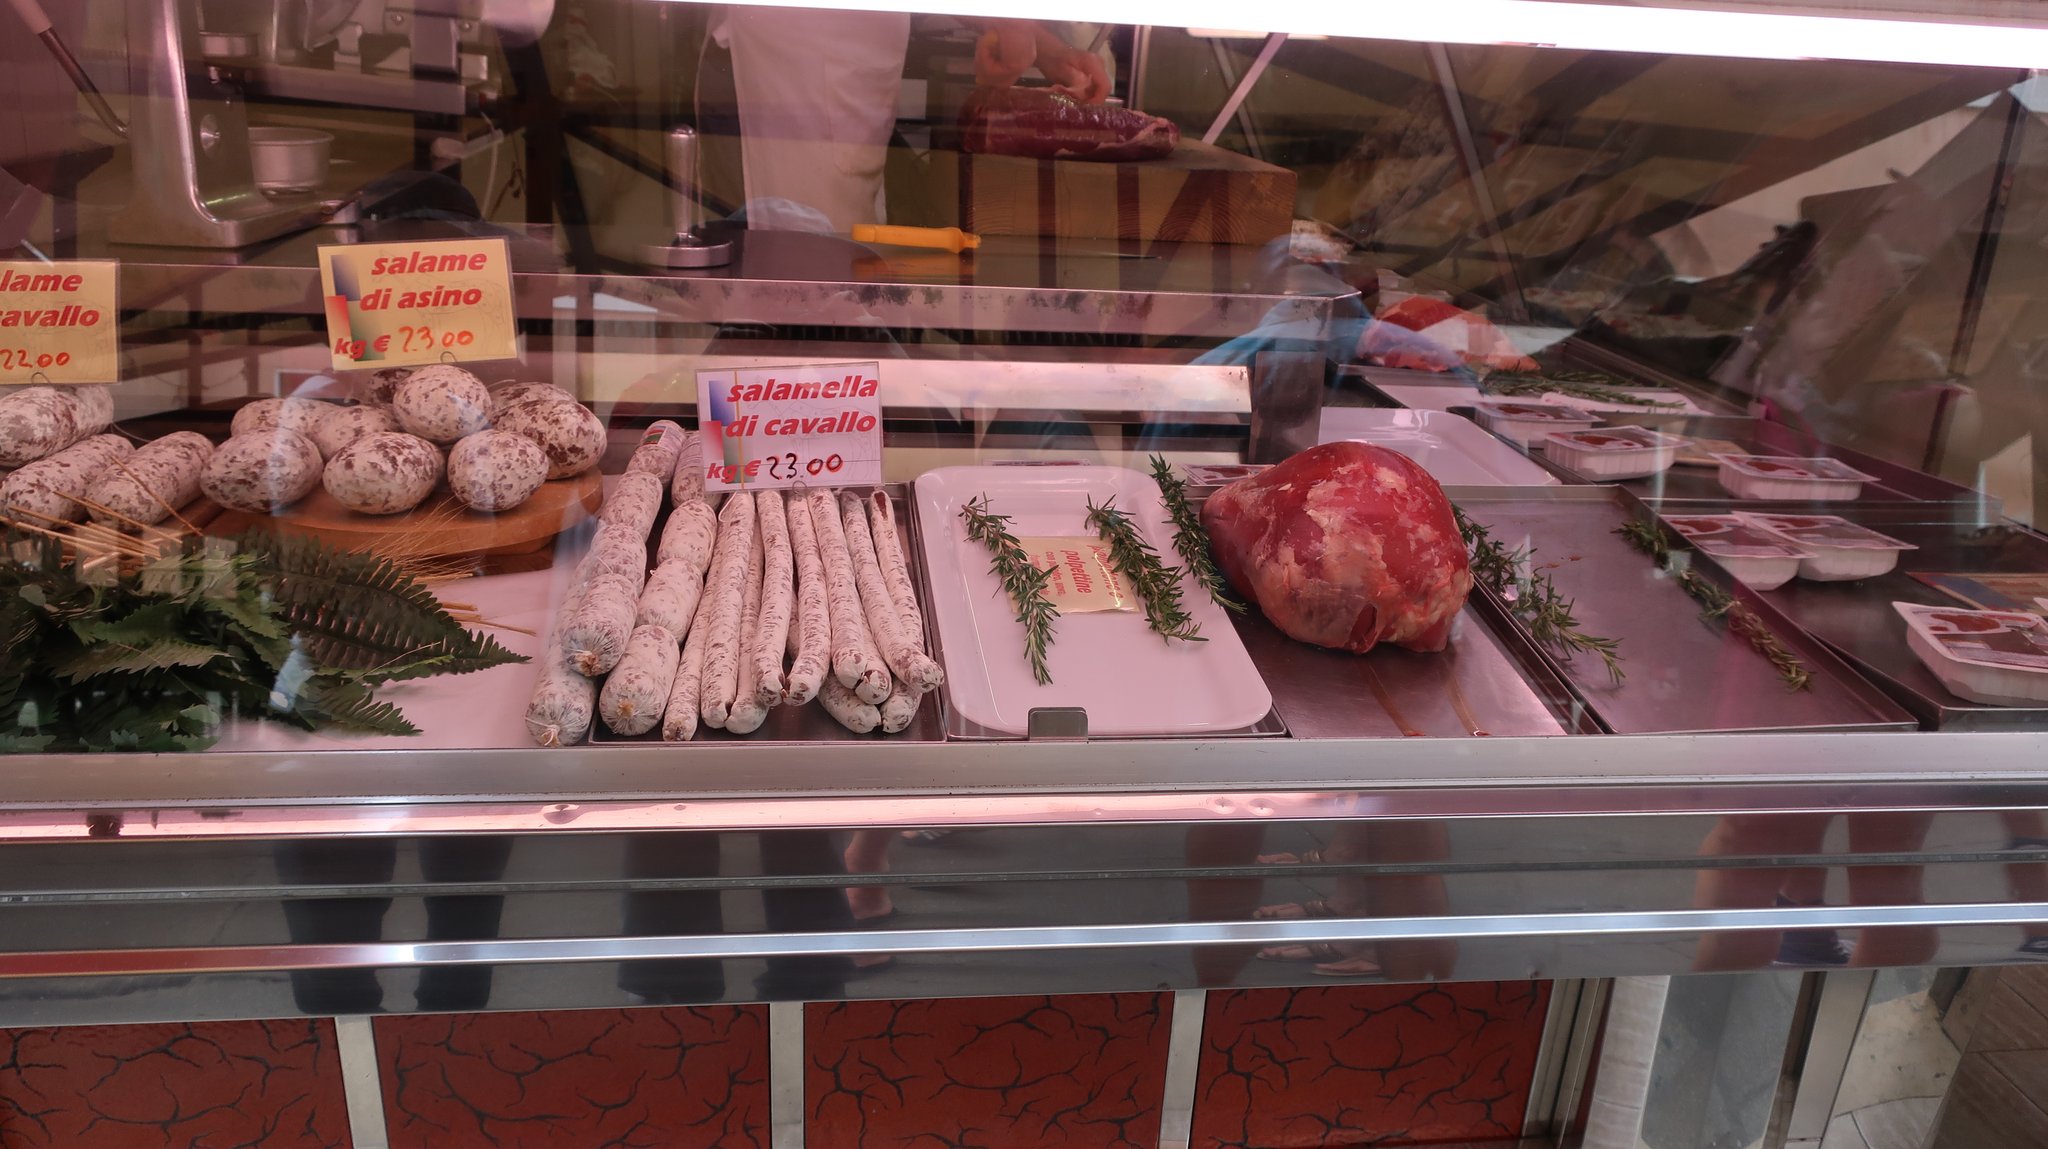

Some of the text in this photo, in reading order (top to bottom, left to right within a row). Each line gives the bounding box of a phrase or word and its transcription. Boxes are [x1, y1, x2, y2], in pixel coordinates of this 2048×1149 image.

[371, 251, 488, 276] salame
[360, 286, 482, 311] di asino
[0, 305, 100, 327] avallo
[334, 338, 367, 359] kg
[373, 334, 391, 353] €
[727, 375, 878, 403] salamella
[725, 411, 877, 438] di cavallo
[706, 463, 738, 483] kg
[743, 460, 761, 477] €
[1060, 550, 1093, 594] polpettine
